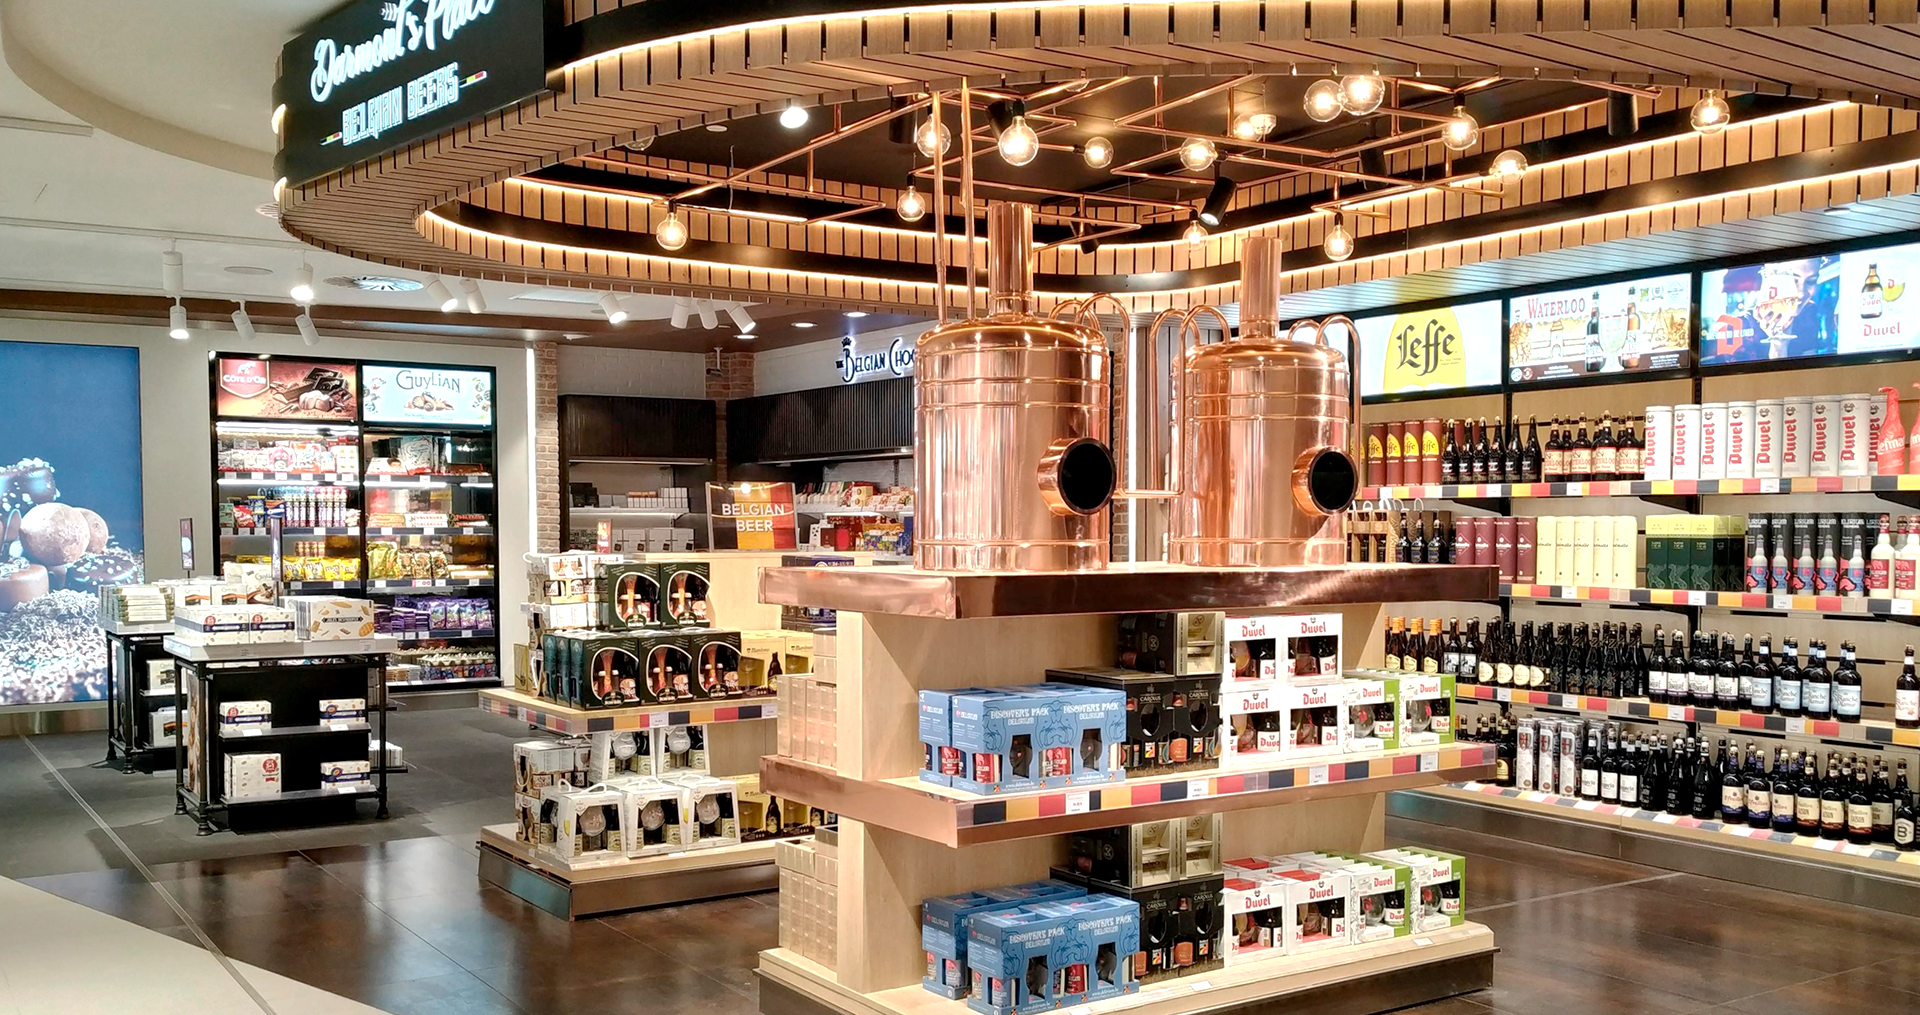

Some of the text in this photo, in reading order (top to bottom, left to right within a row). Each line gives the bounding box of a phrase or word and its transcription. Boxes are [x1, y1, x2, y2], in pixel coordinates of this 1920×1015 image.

[342, 61, 458, 147] BELGIAN BEERS
[1863, 322, 1901, 336] Duvel
[1396, 318, 1456, 377] Leffe
[842, 348, 886, 383] BELGIAN
[1674, 424, 1686, 465] Duvel
[1702, 423, 1715, 465] Duvel
[1729, 421, 1743, 465] Duvel
[1756, 419, 1771, 463] Duvel
[1783, 418, 1797, 463] Duvel
[1811, 417, 1827, 462] Duvel
[1841, 415, 1856, 461] Duvel
[1644, 426, 1656, 466] Duvel
[722, 502, 785, 516] BELGIAN
[736, 519, 774, 532] BEER
[1242, 624, 1265, 637] Duvel
[1300, 621, 1327, 634] Duvel
[1363, 688, 1382, 698] Duvel
[1420, 682, 1438, 693] Duvel
[1243, 697, 1269, 711] Duvel
[1303, 692, 1327, 705] Duvel
[1031, 707, 1050, 716] PACK
[1102, 702, 1119, 711] PACK
[1897, 826, 1908, 838] B
[1432, 866, 1449, 878] Duvel
[1373, 875, 1393, 887] Duvel
[1309, 885, 1334, 900] Duvel
[1245, 893, 1271, 909] Duvel
[1115, 914, 1133, 925] PACK
[1048, 926, 1065, 938] PACK
